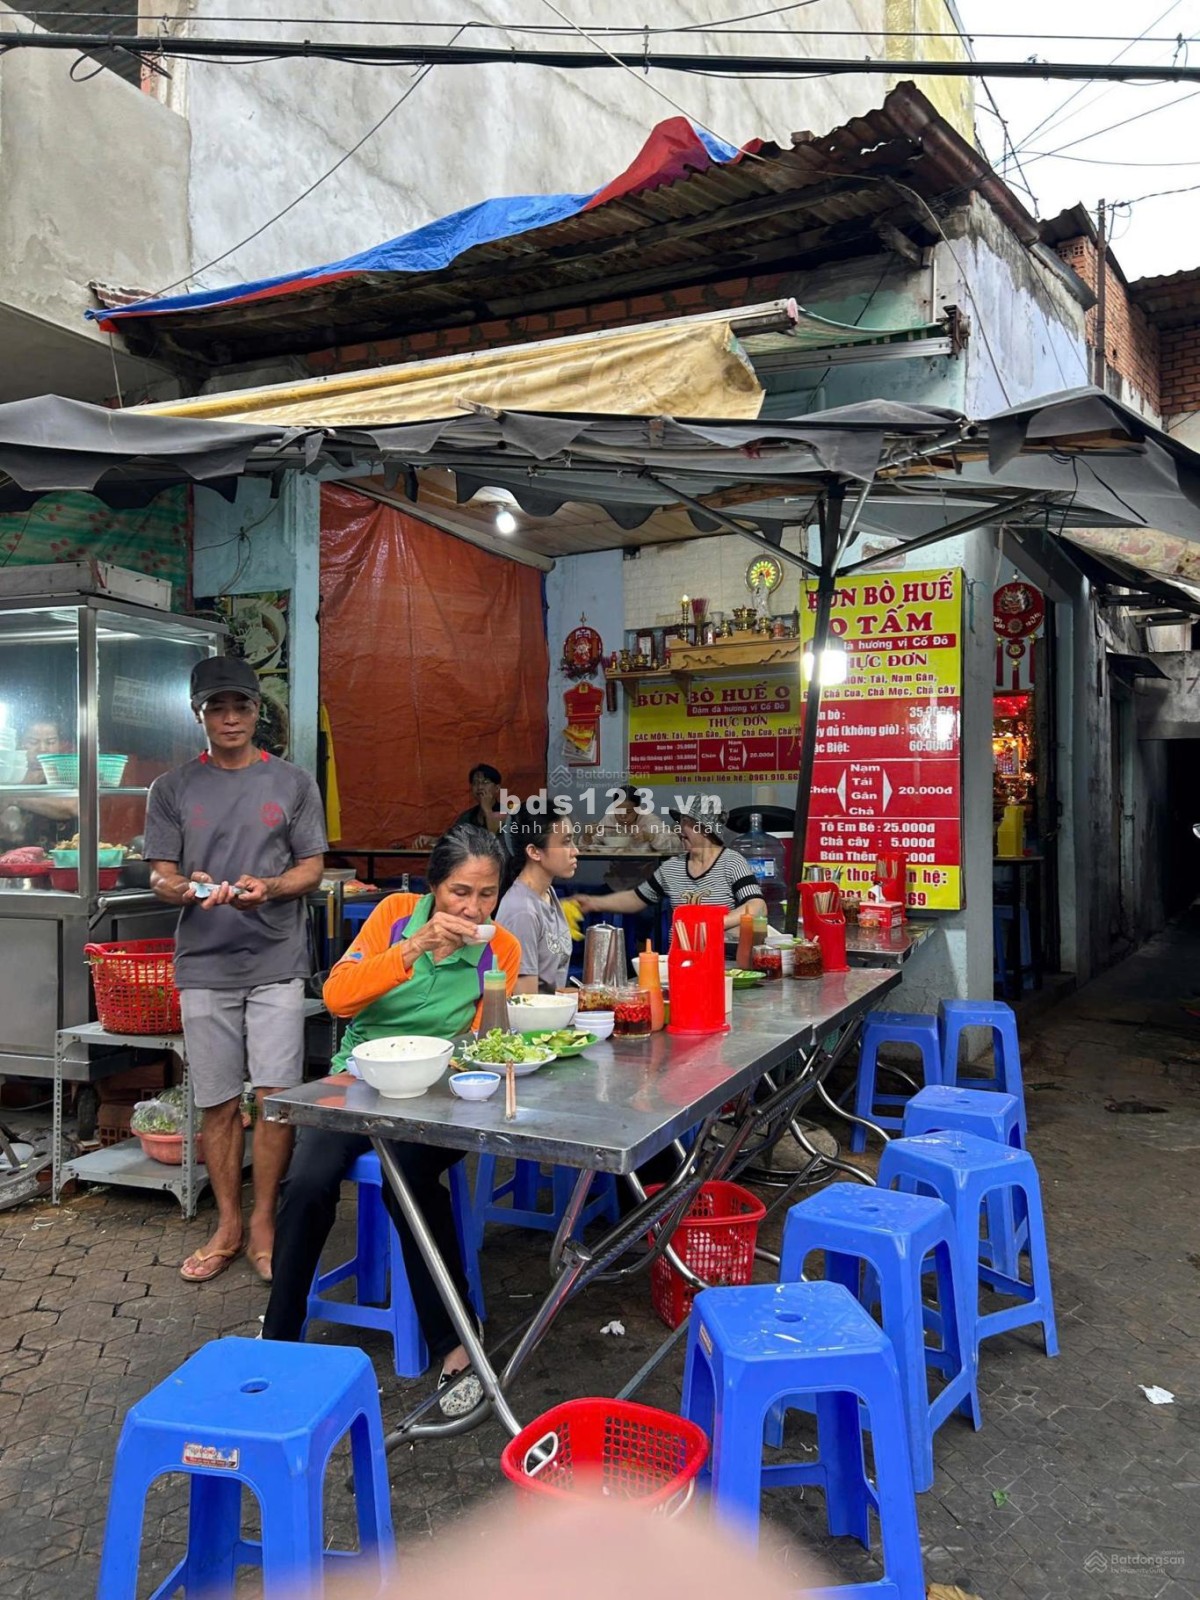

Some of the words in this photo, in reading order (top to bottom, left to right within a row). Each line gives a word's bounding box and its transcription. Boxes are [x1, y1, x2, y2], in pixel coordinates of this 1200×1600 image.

[864, 580, 895, 606] BÒ
[903, 572, 953, 603] HUẾ
[857, 604, 933, 635] TẤM
[858, 640, 893, 651] hương
[898, 638, 908, 649] vị
[913, 637, 928, 647] Cố
[933, 636, 948, 646] Đô
[887, 652, 927, 667] ĐƠN
[688, 687, 715, 704] BÒ
[722, 682, 768, 702] HUẾ
[774, 685, 790, 699] O
[844, 688, 864, 698] Cua,
[867, 687, 885, 696] Chả
[937, 685, 956, 695] cây
[709, 716, 740, 728] THỰC
[743, 714, 768, 727] ĐƠN
[827, 724, 839, 736] đủ
[841, 725, 877, 737] (không
[878, 723, 900, 736] giò)
[826, 742, 850, 755] Biệt:
[850, 764, 881, 773] Nạm
[749, 773, 799, 781] 0961.910.66
[852, 777, 873, 786] Tái
[851, 791, 878, 800] Gân
[898, 786, 953, 795] 20.000đ
[849, 806, 875, 816] Chả
[820, 821, 835, 832] Tô
[837, 822, 856, 832] Em
[859, 821, 876, 832] Bé
[883, 822, 935, 833] 25.000đ
[820, 836, 843, 847] Chả
[847, 837, 870, 848] cây
[890, 837, 935, 848] 5.000đ
[820, 851, 844, 861] Bún
[923, 869, 947, 887] hệ:
